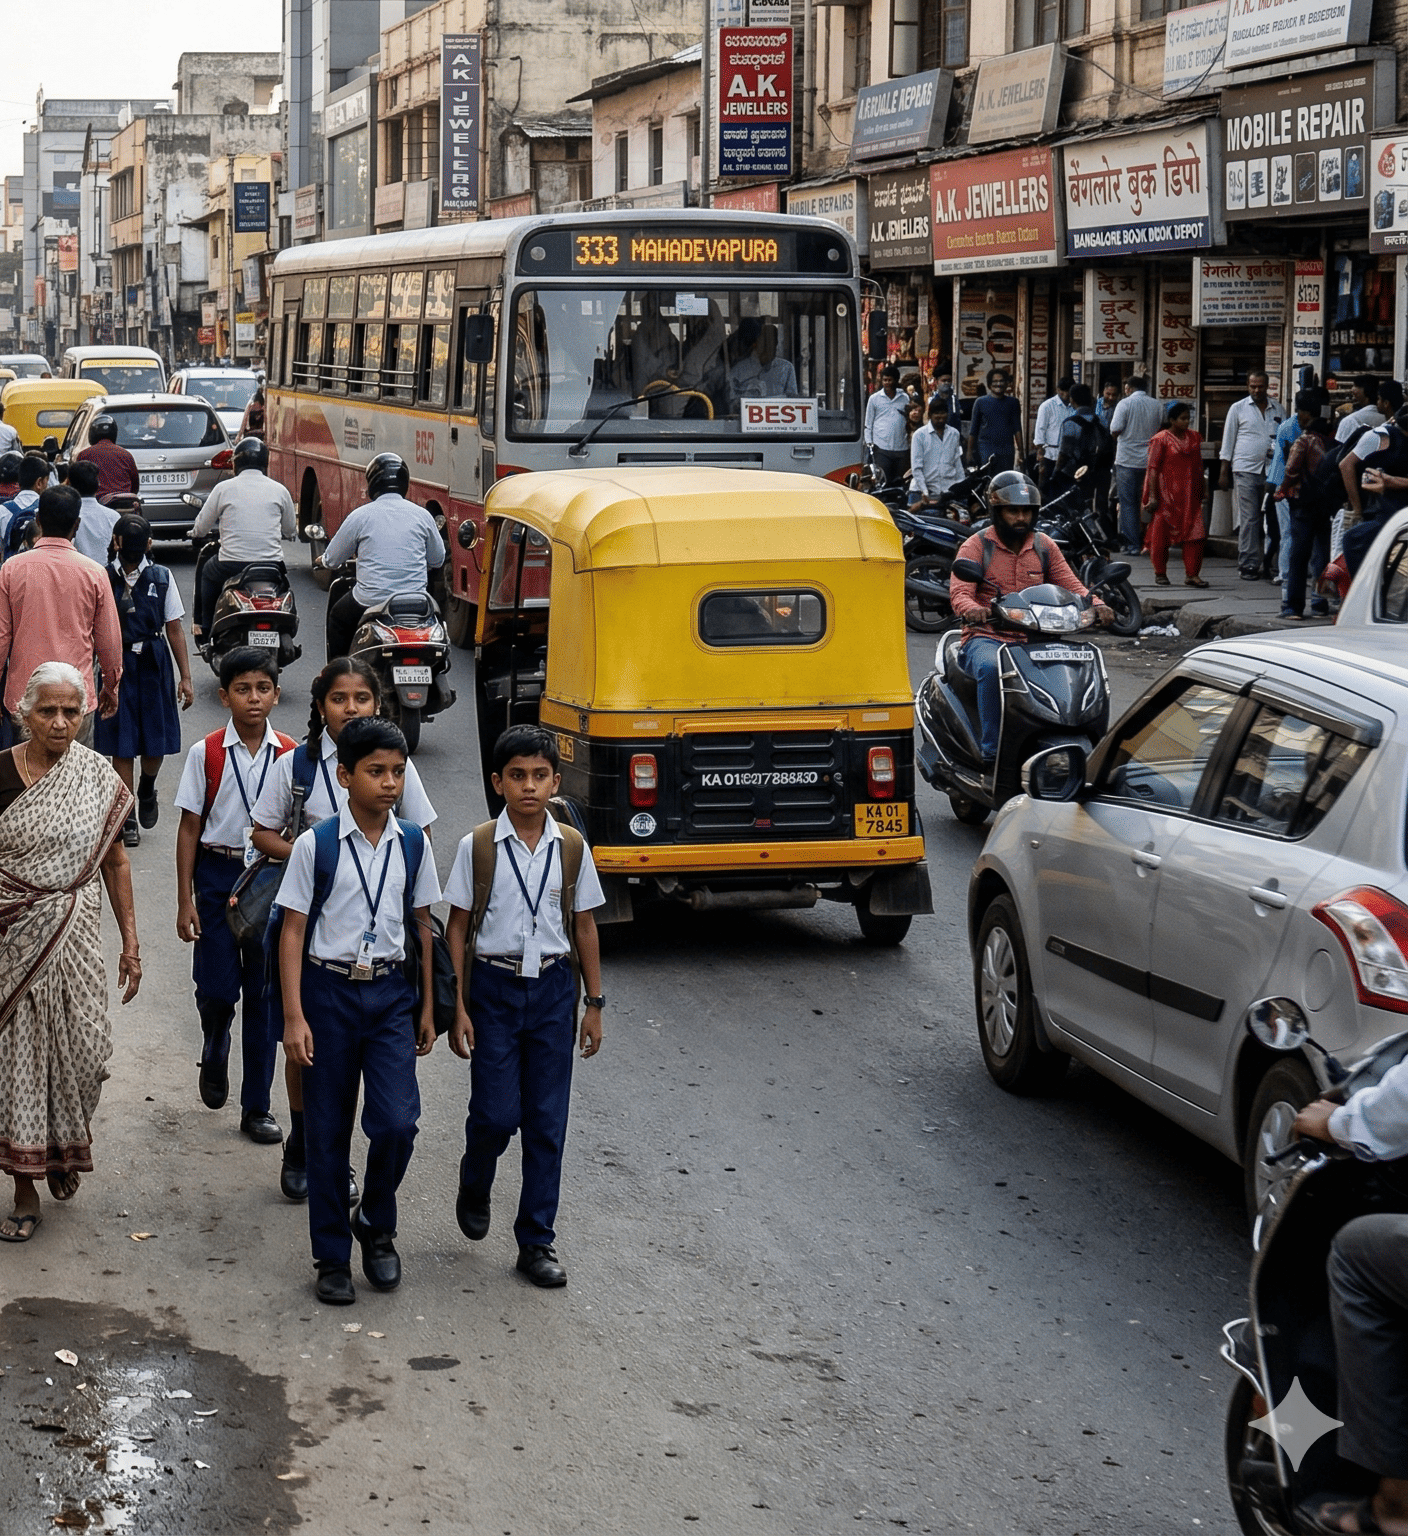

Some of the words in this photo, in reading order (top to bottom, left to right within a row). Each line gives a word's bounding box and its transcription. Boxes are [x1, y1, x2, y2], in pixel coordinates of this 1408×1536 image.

[727, 74, 786, 98] A.K.
[722, 102, 788, 116] JEWELLERS
[1226, 109, 1292, 152] MOBILE
[1297, 98, 1365, 142] REPAIR
[818, 192, 854, 214] REPAIRS
[935, 188, 962, 224] A.K.
[964, 174, 1049, 221] JEWELLERS
[576, 235, 619, 265] 333
[631, 238, 779, 263] MAHADEVAPURA
[748, 405, 812, 424] BEST
[702, 774, 722, 786] KA
[866, 805, 882, 818] KA
[886, 804, 898, 817] 01
[865, 819, 903, 834] 7845
